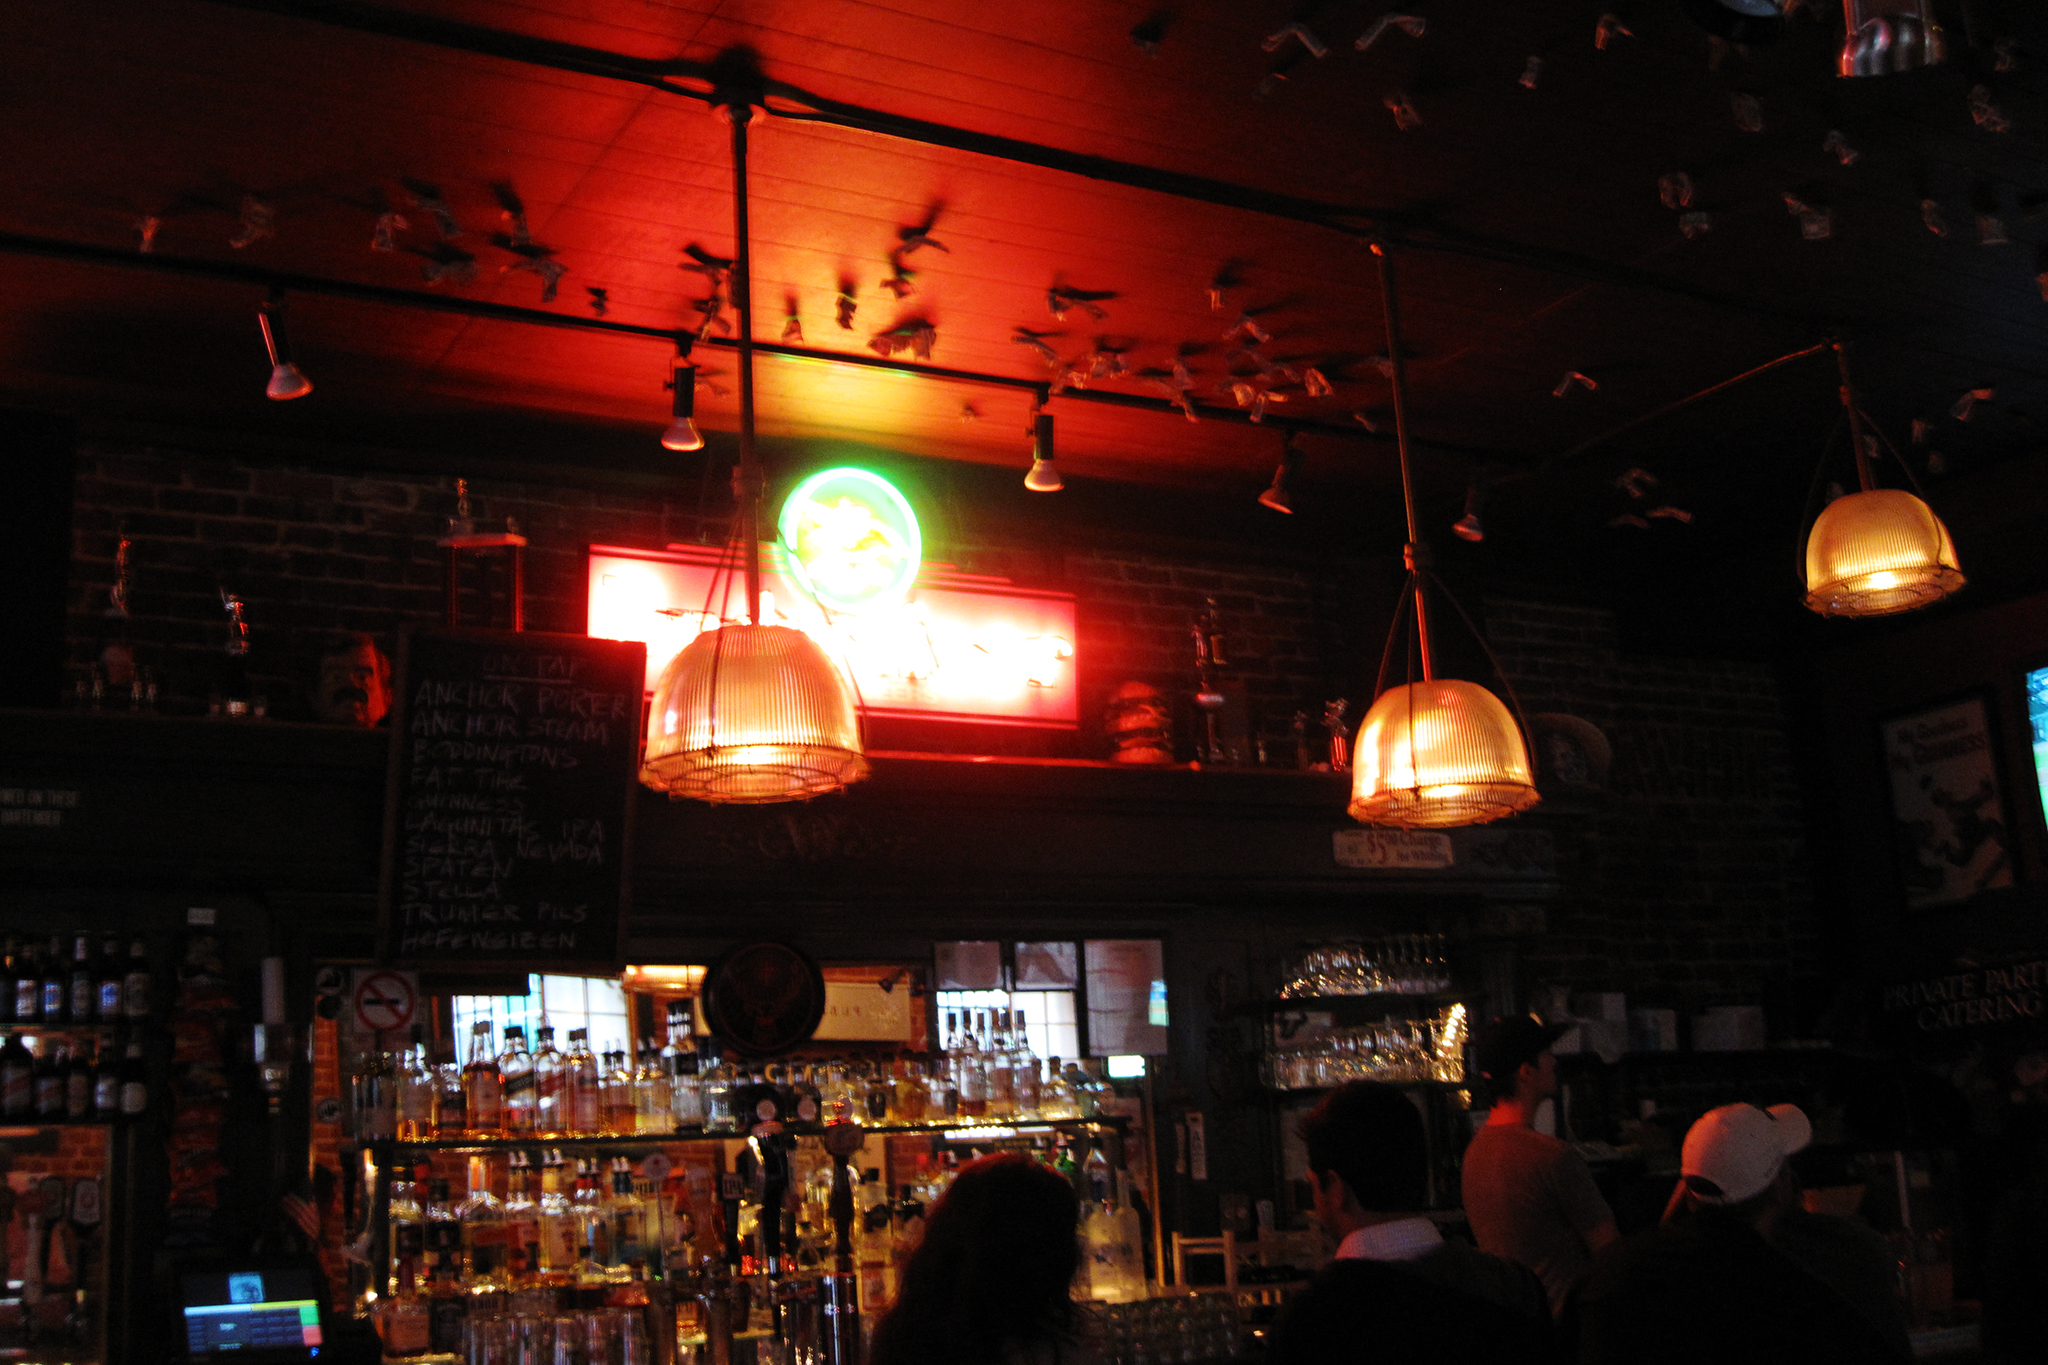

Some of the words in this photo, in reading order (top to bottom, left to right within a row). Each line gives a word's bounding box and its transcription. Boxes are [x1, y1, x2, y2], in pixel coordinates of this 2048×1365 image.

[414, 679, 520, 715] ANCHOR
[538, 687, 628, 721] PORTER
[411, 709, 520, 738] ANCHOR
[527, 717, 609, 746] STEAM
[413, 739, 578, 768] BODDINGTONS
[410, 766, 463, 790] FAT
[563, 819, 605, 843] IPA
[403, 857, 514, 880] SPATEN
[402, 881, 499, 900] STELLA
[400, 902, 521, 925] TRUMER
[538, 901, 588, 923] PILS
[1882, 973, 1977, 1011] PRIVATE
[1917, 990, 2043, 1031] CATERING
